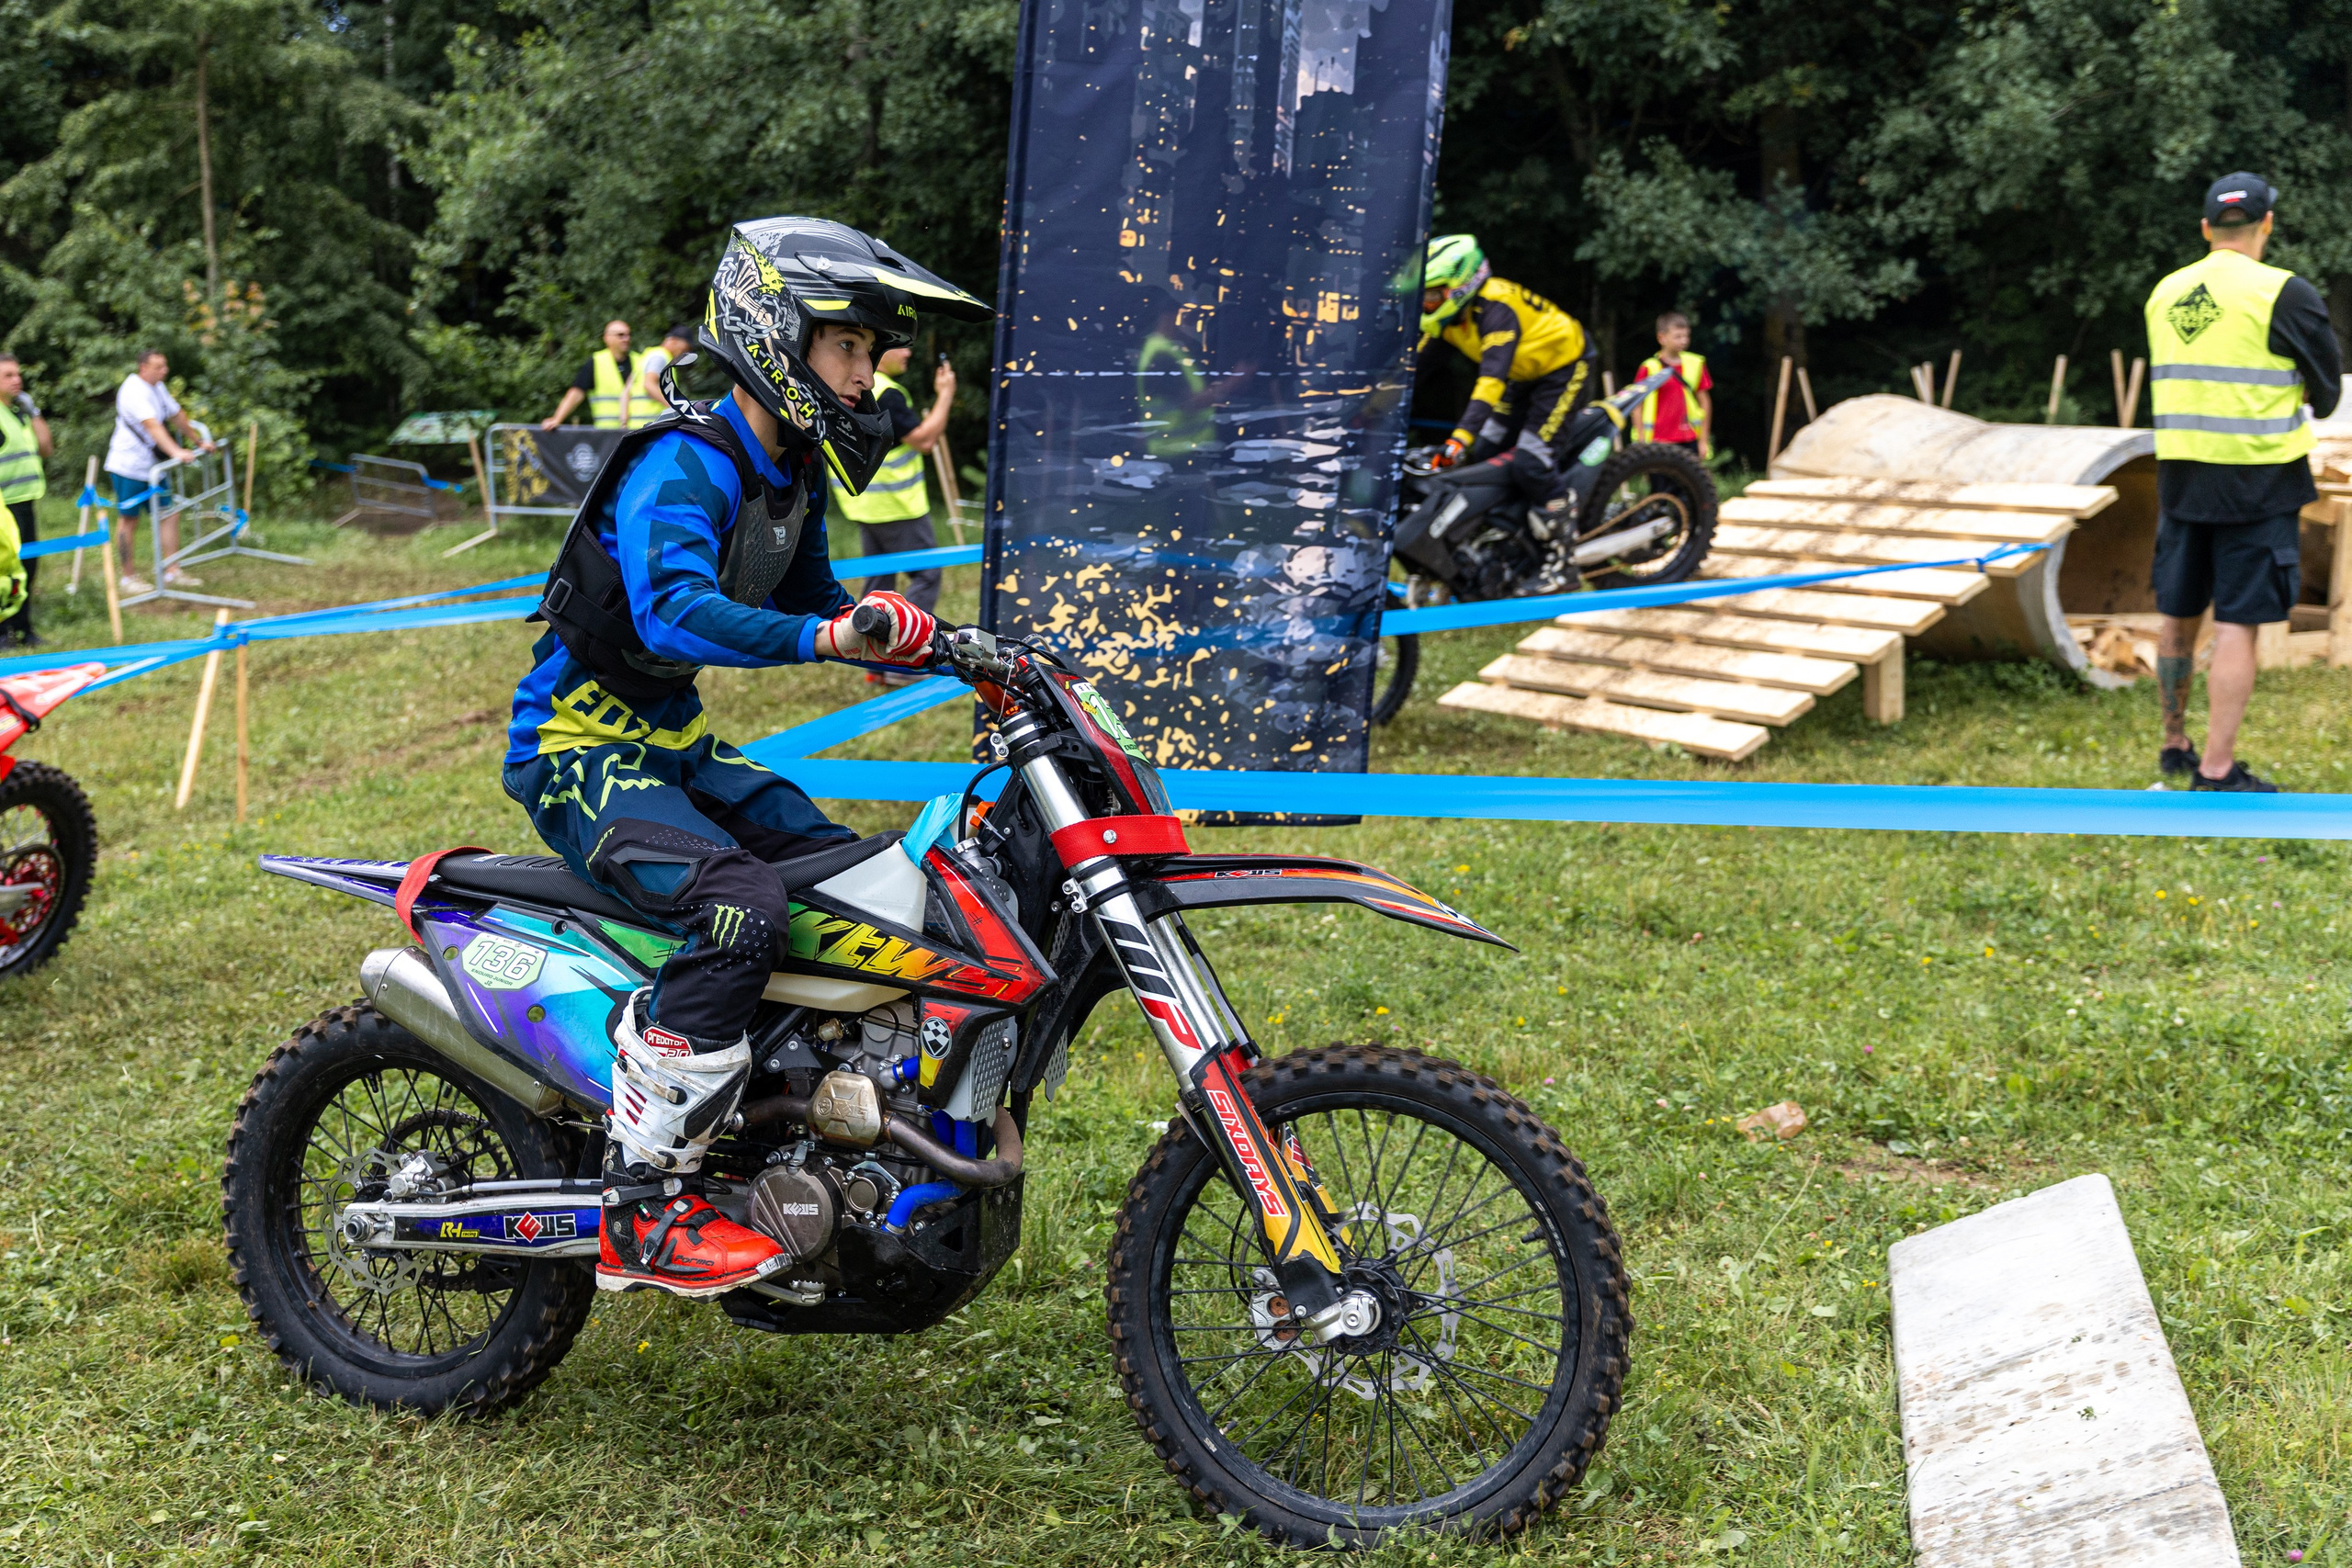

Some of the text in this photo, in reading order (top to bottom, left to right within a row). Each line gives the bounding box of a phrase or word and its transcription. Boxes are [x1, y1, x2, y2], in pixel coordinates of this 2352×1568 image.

[746, 344, 816, 419] AIROH
[469, 941, 537, 981] 136
[470, 968, 514, 987] ENDURO JUNIOR
[1206, 1089, 1288, 1217] SIXDAYS
